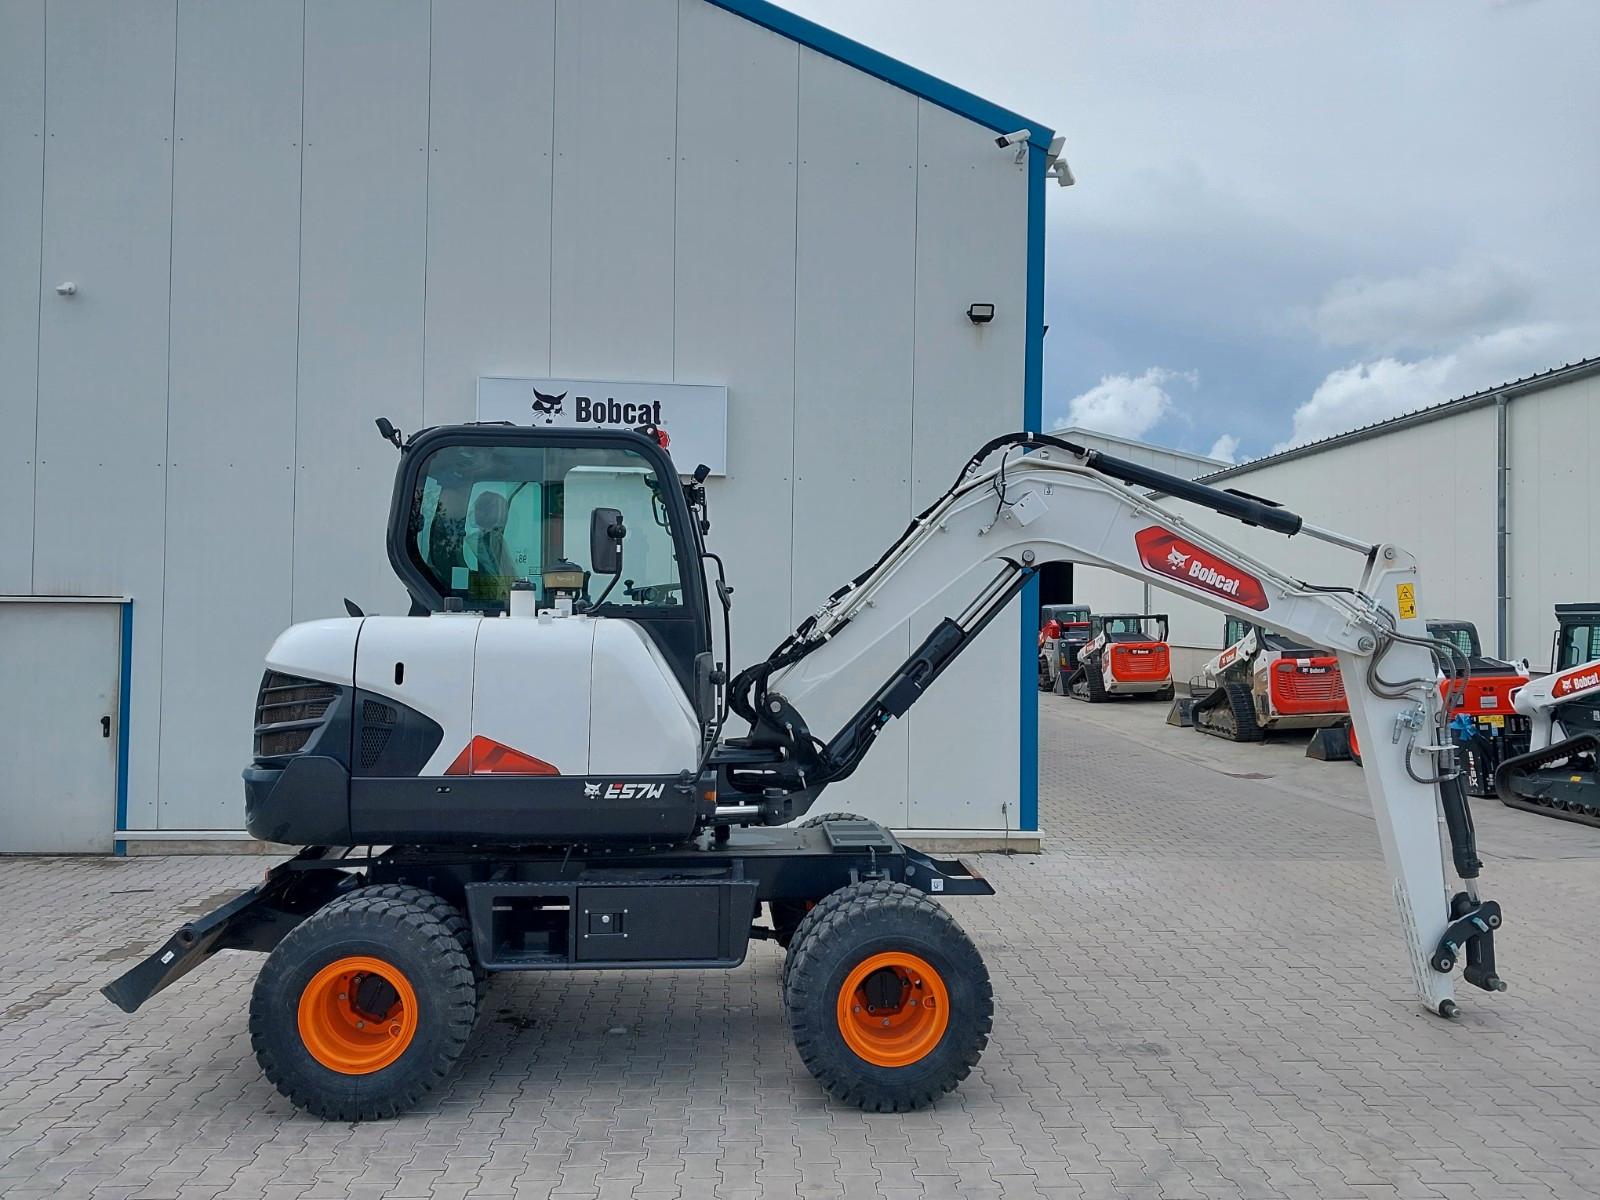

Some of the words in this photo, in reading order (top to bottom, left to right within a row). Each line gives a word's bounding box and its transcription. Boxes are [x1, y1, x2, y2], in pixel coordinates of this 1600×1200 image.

[575, 396, 661, 425] Bobcat
[1189, 560, 1239, 595] Bobcat
[1573, 672, 1599, 689] Bobcat
[604, 783, 665, 799] E57W
